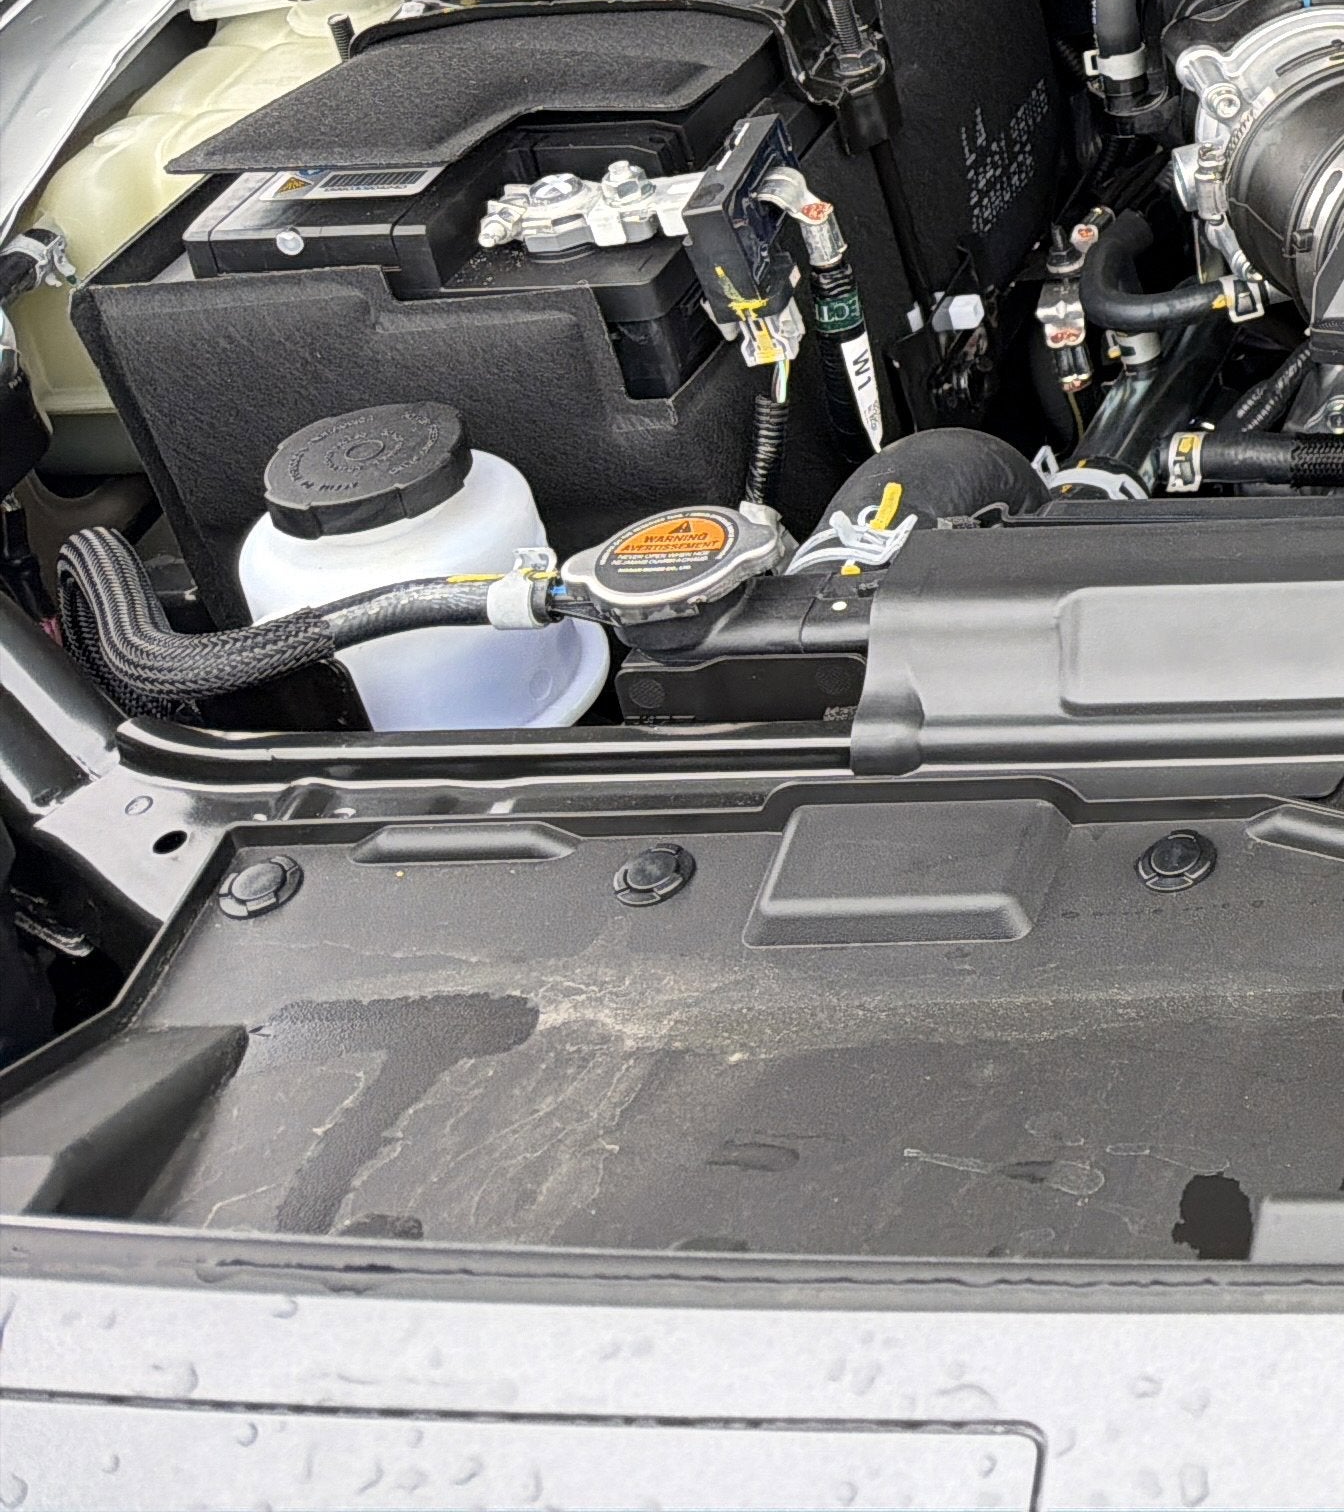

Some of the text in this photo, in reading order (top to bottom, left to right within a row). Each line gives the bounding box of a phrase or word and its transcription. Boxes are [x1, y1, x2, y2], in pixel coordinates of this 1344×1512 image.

[853, 348, 872, 391] W1
[643, 532, 708, 543] WARNING
[621, 539, 720, 552] AVERTISSEMENT
